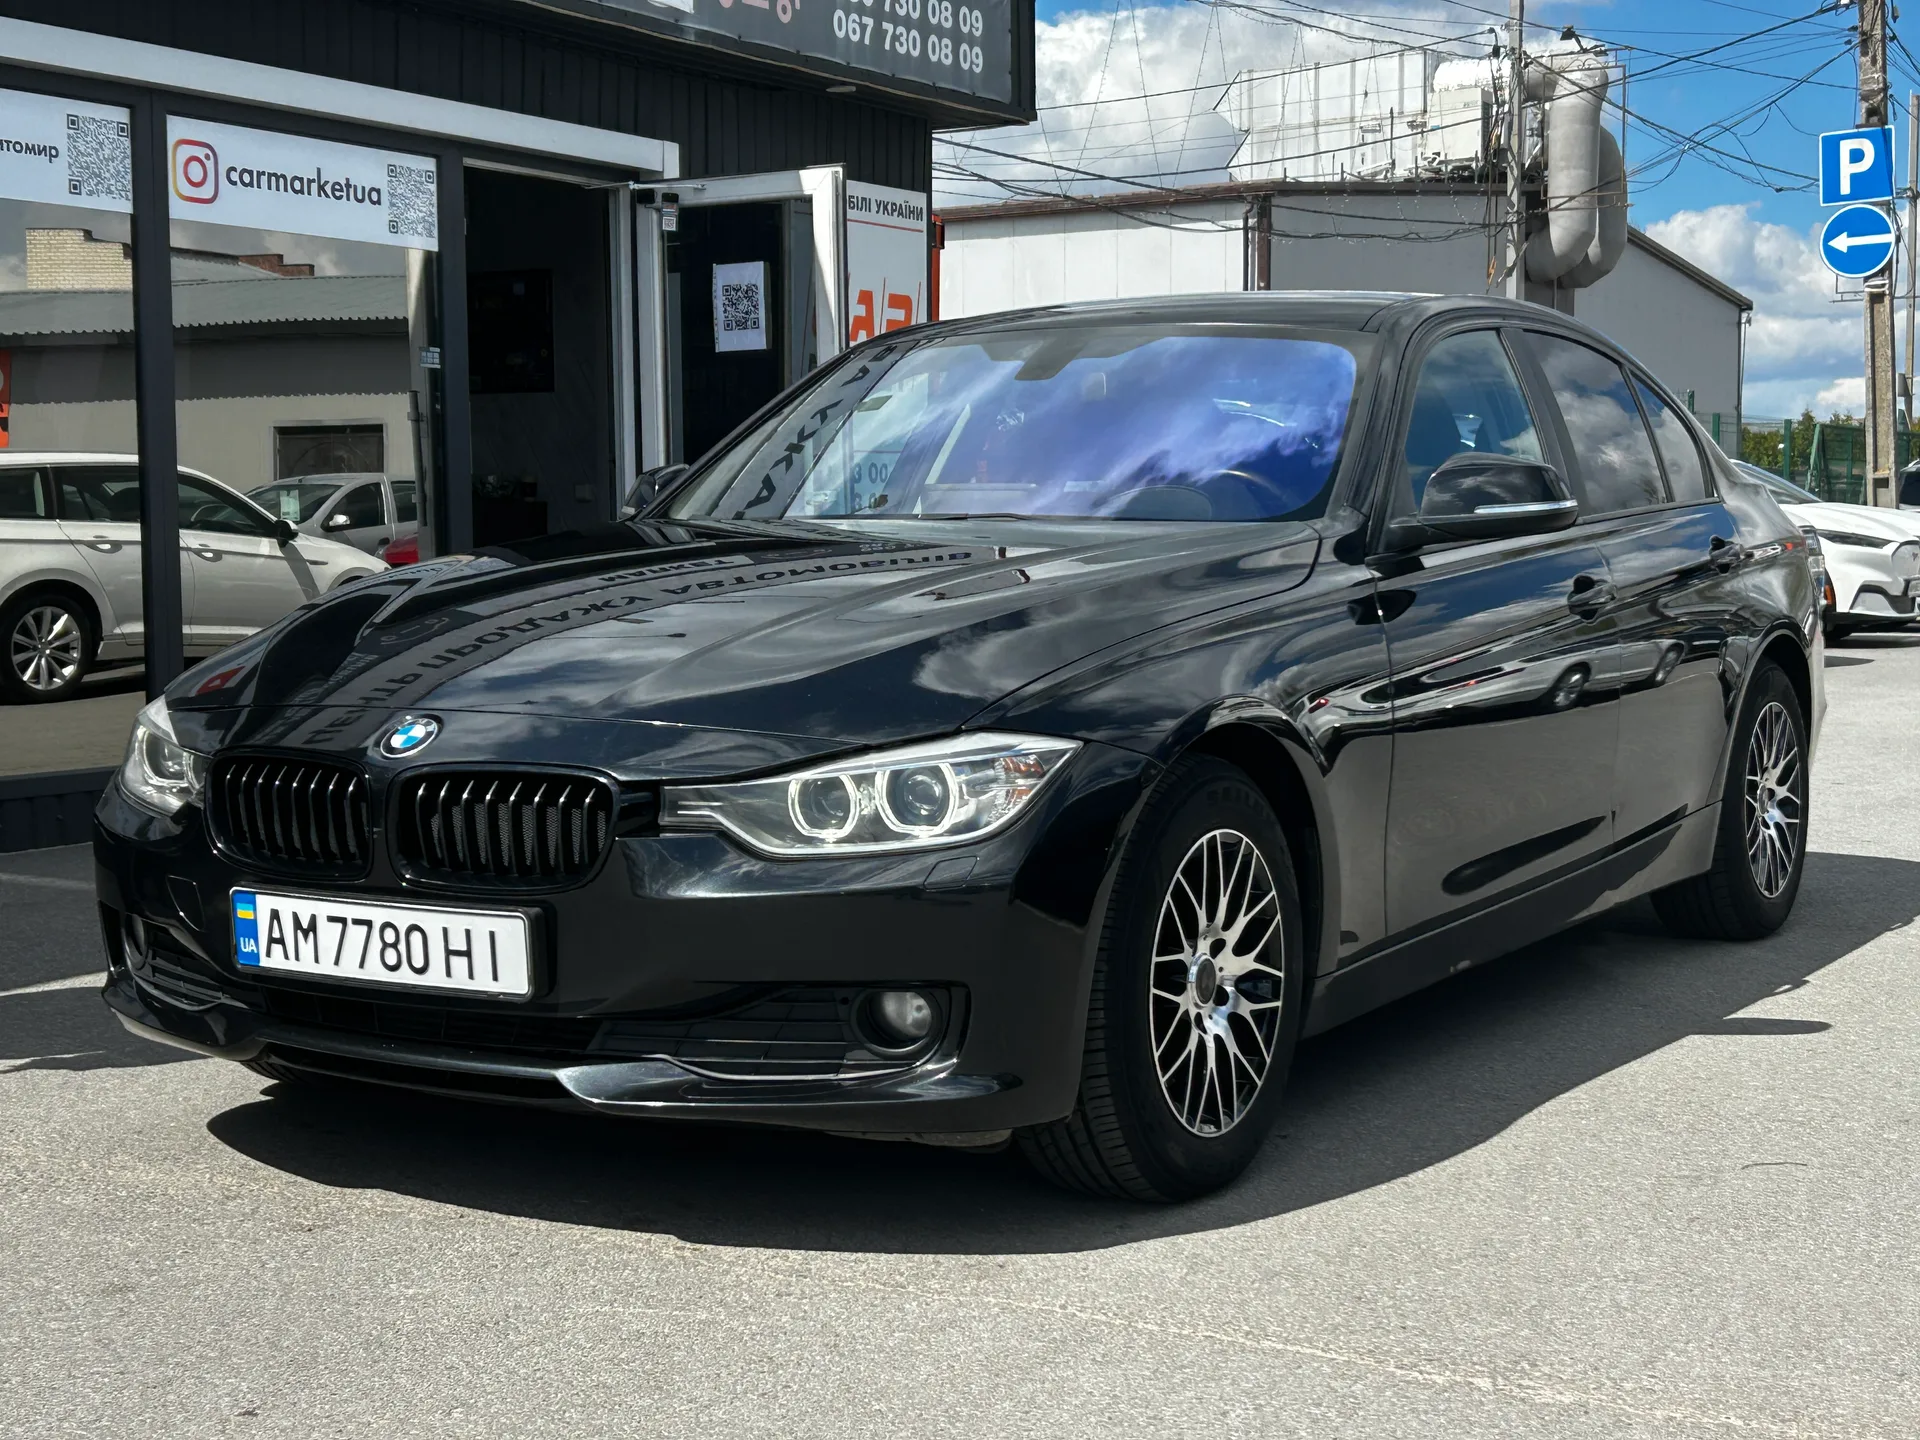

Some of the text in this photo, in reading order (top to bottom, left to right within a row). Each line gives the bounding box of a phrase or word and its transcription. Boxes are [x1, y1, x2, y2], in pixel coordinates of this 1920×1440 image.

[928, 0, 953, 28] 08
[959, 6, 983, 37] 09
[833, 9, 983, 73] 067 730 08 09
[1839, 138, 1875, 195] P
[225, 166, 382, 206] carmarketua
[848, 194, 924, 222] БІЛІ УКРАЇНИ
[240, 937, 257, 954] UA
